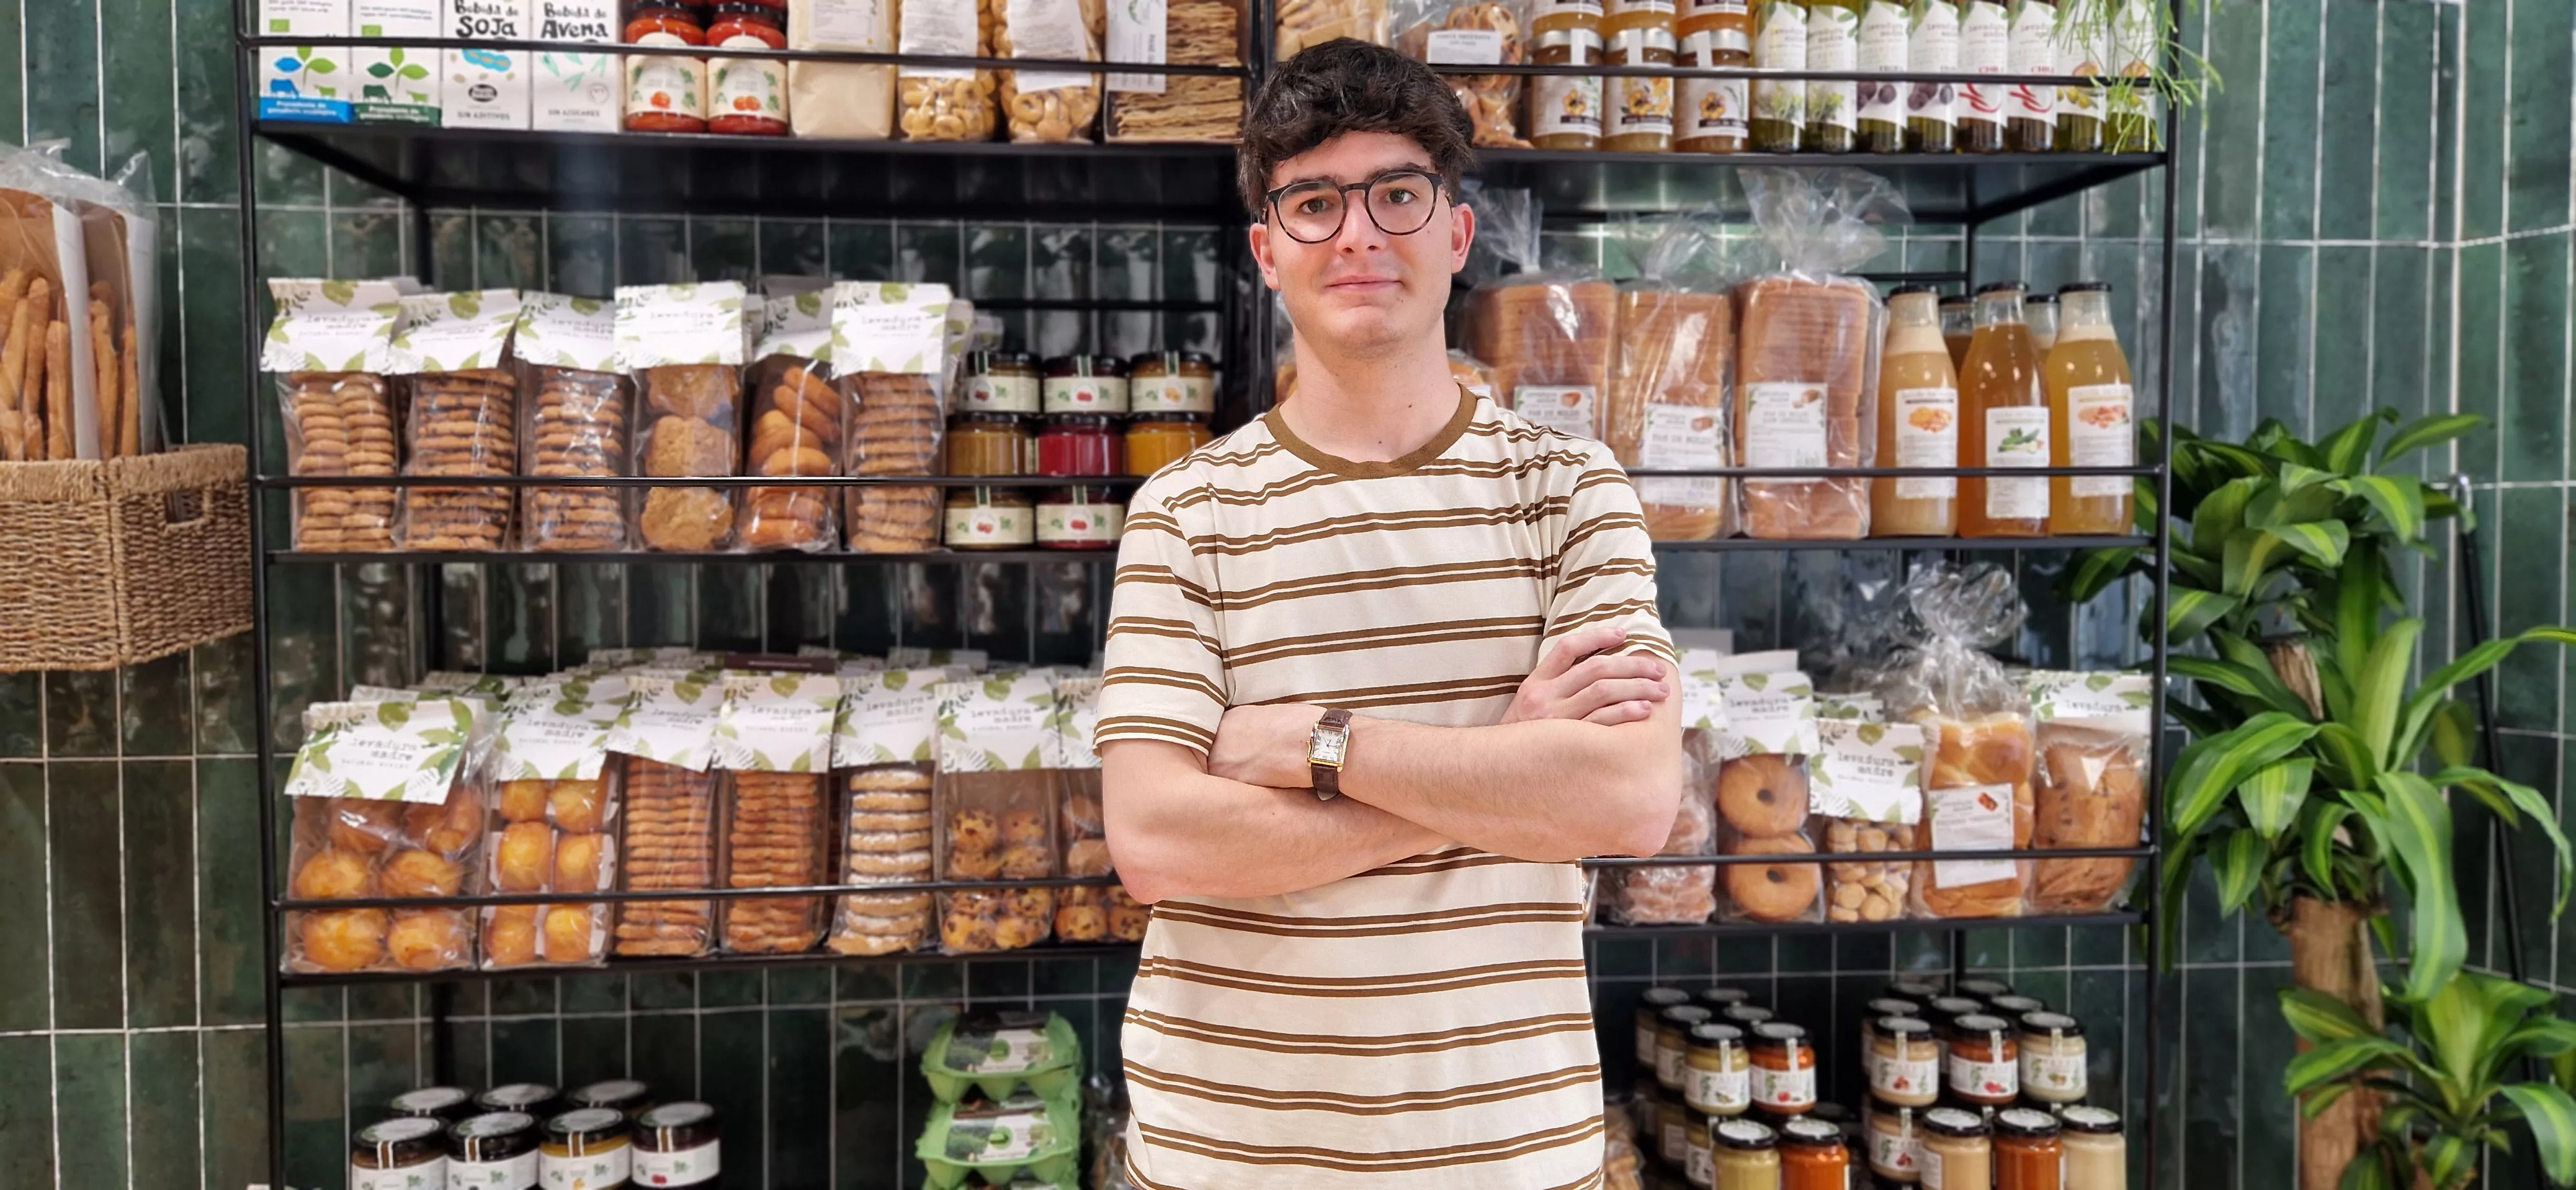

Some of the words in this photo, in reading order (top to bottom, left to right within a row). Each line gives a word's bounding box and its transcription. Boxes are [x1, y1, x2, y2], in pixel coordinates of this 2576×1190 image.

[455, 0, 501, 15] Bebida
[506, 6, 519, 17] de
[544, 2, 590, 18] Bebida
[594, 8, 607, 19] de
[866, 696, 923, 712] levadura
[1729, 697, 1788, 708] levadura
[751, 704, 811, 717] levadura
[970, 706, 1031, 719] levadura
[527, 719, 589, 731] levadura
[544, 730, 585, 738] madre
[348, 737, 417, 751] levadura
[370, 750, 413, 761] madre
[1837, 751, 1895, 767] levadura
[1857, 766, 1894, 777] madre
